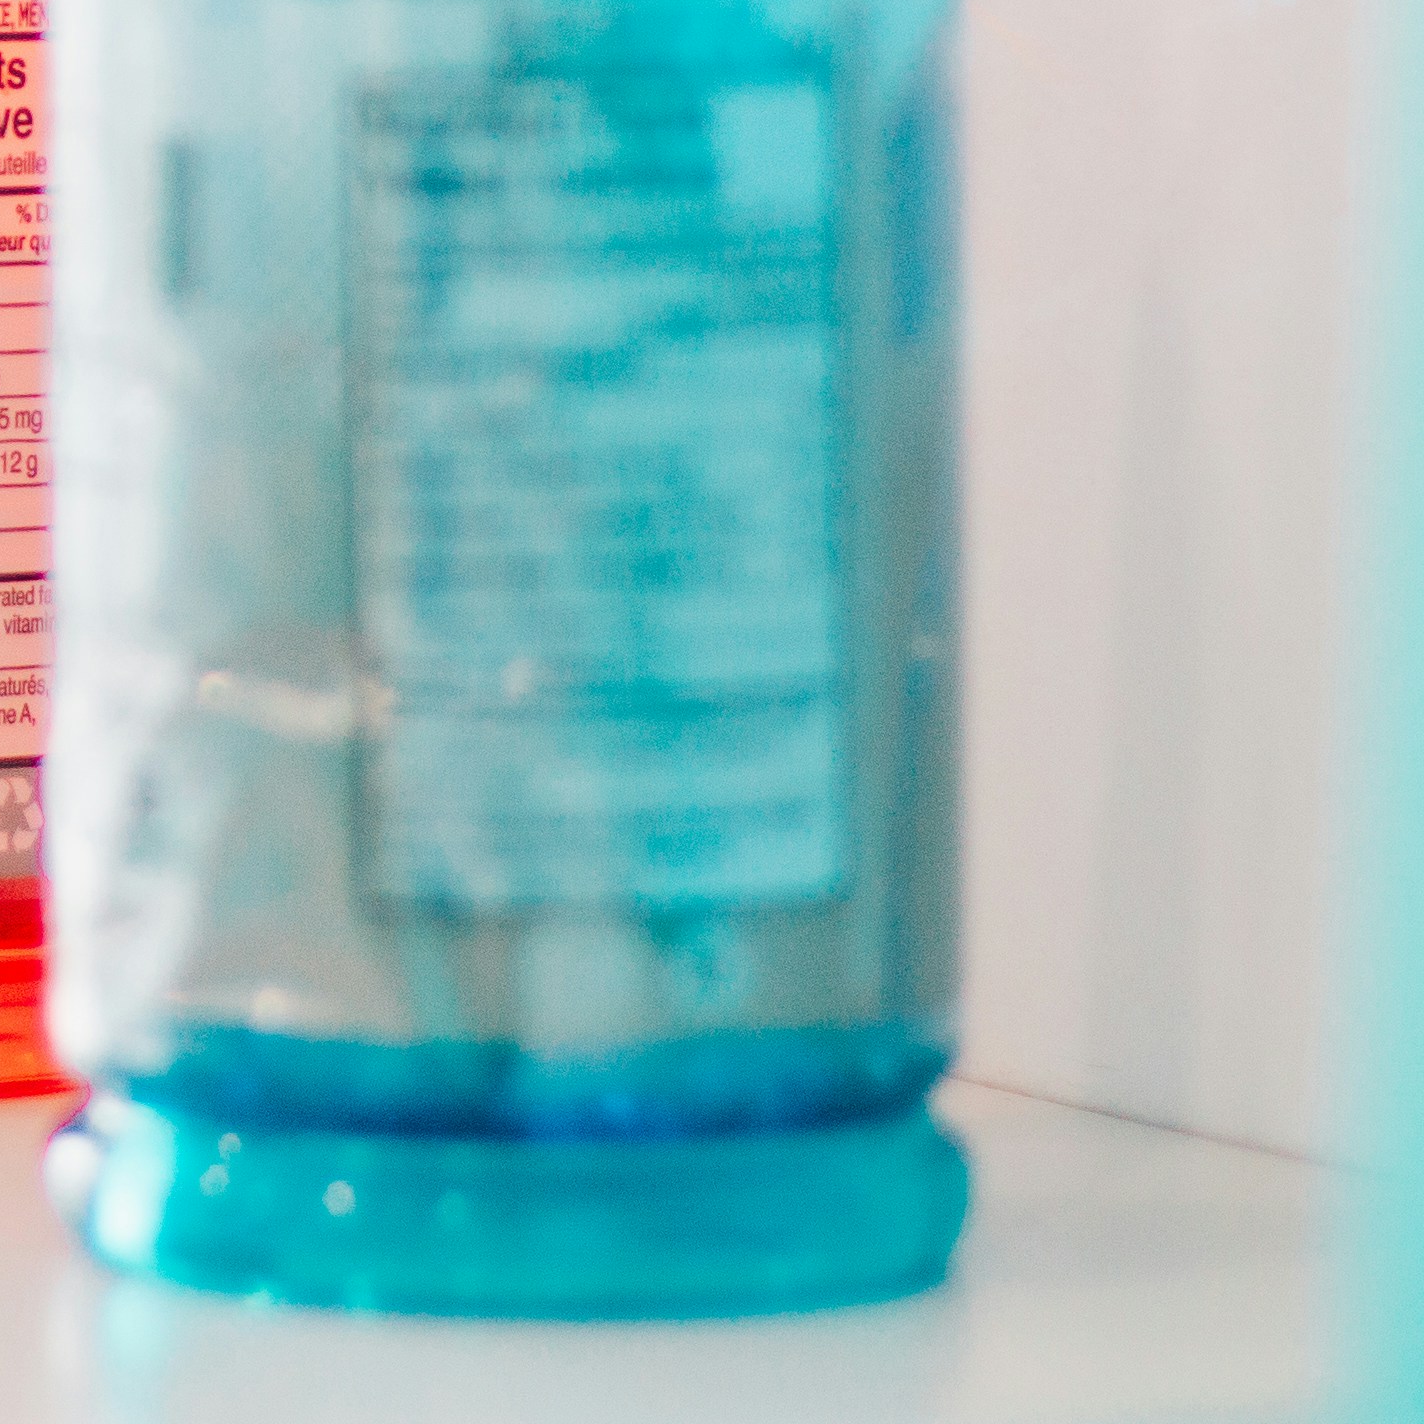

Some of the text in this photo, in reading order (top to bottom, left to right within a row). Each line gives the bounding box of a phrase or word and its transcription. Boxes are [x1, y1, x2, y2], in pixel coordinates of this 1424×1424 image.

[15, 203, 33, 224] %
[15, 409, 43, 434] mg
[0, 452, 21, 473] 12
[26, 454, 39, 478] g
[18, 703, 37, 727] A,
